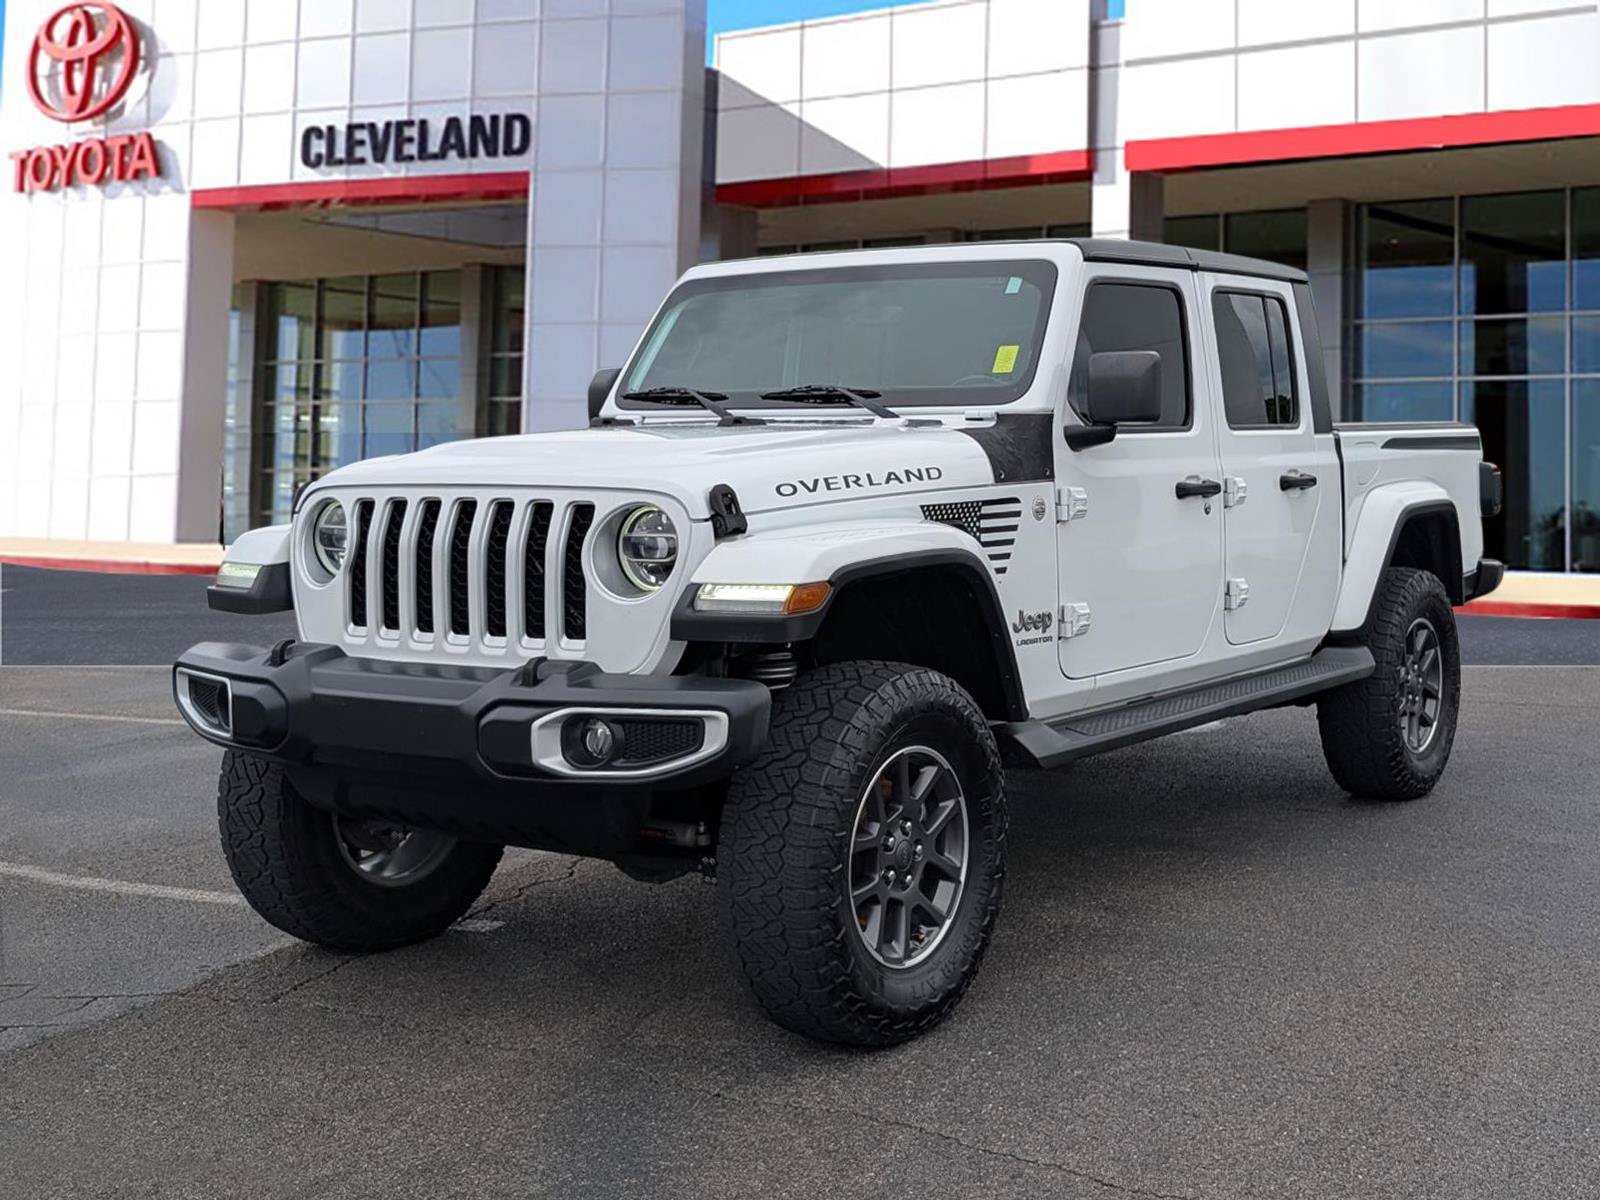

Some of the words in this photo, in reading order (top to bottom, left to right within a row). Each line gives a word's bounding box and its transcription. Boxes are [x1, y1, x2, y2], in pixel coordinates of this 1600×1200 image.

[9, 131, 161, 193] TOYOTA
[301, 113, 532, 168] CLEVELAND
[775, 466, 943, 497] OVERLAND
[1012, 609, 1053, 634] Jeep
